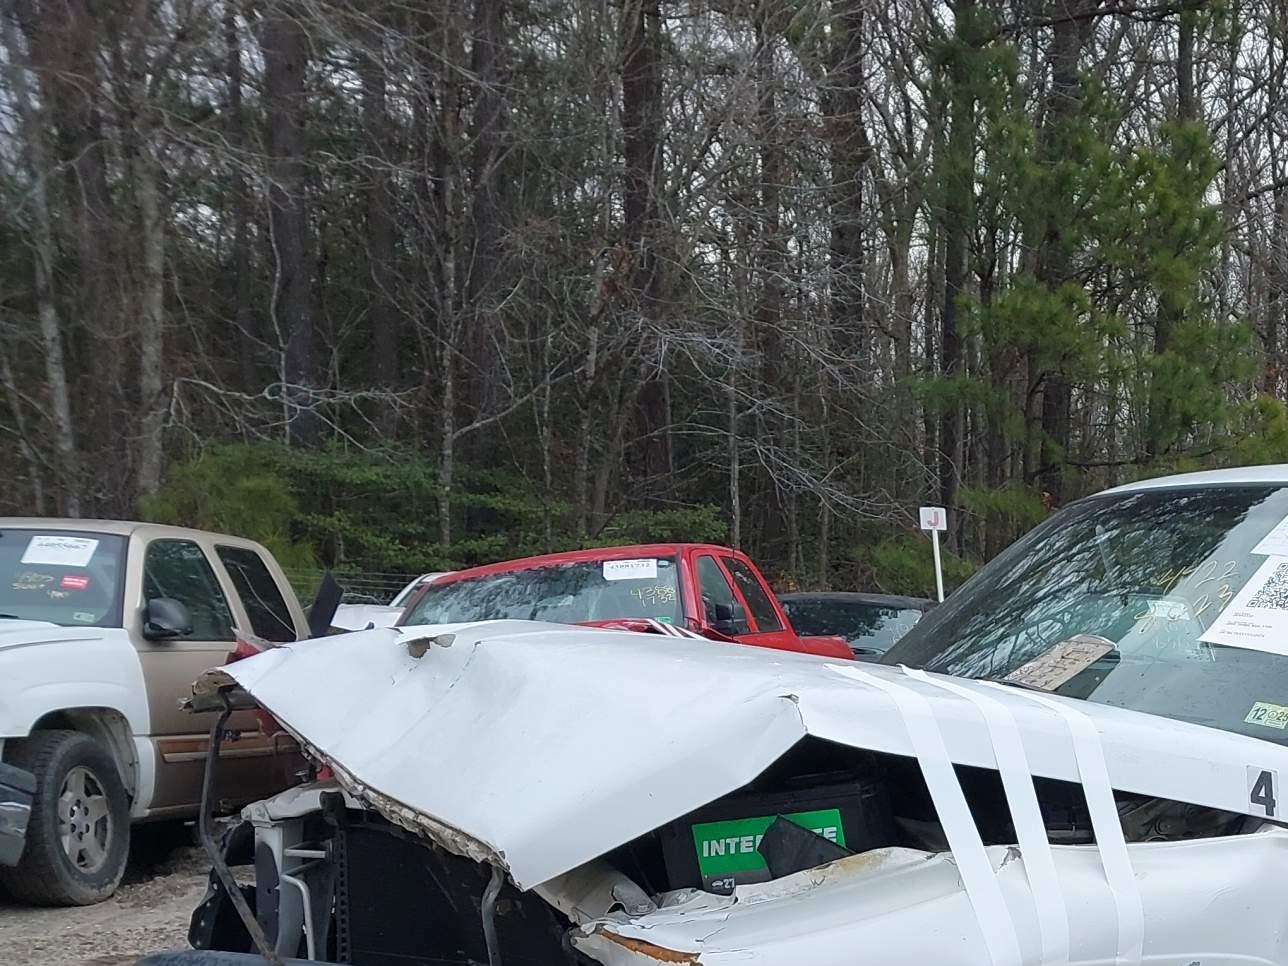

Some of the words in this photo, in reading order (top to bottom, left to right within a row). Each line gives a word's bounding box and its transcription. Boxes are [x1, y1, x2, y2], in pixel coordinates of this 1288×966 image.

[927, 511, 939, 526] J
[1252, 707, 1268, 721] 12
[1250, 770, 1276, 817] 4
